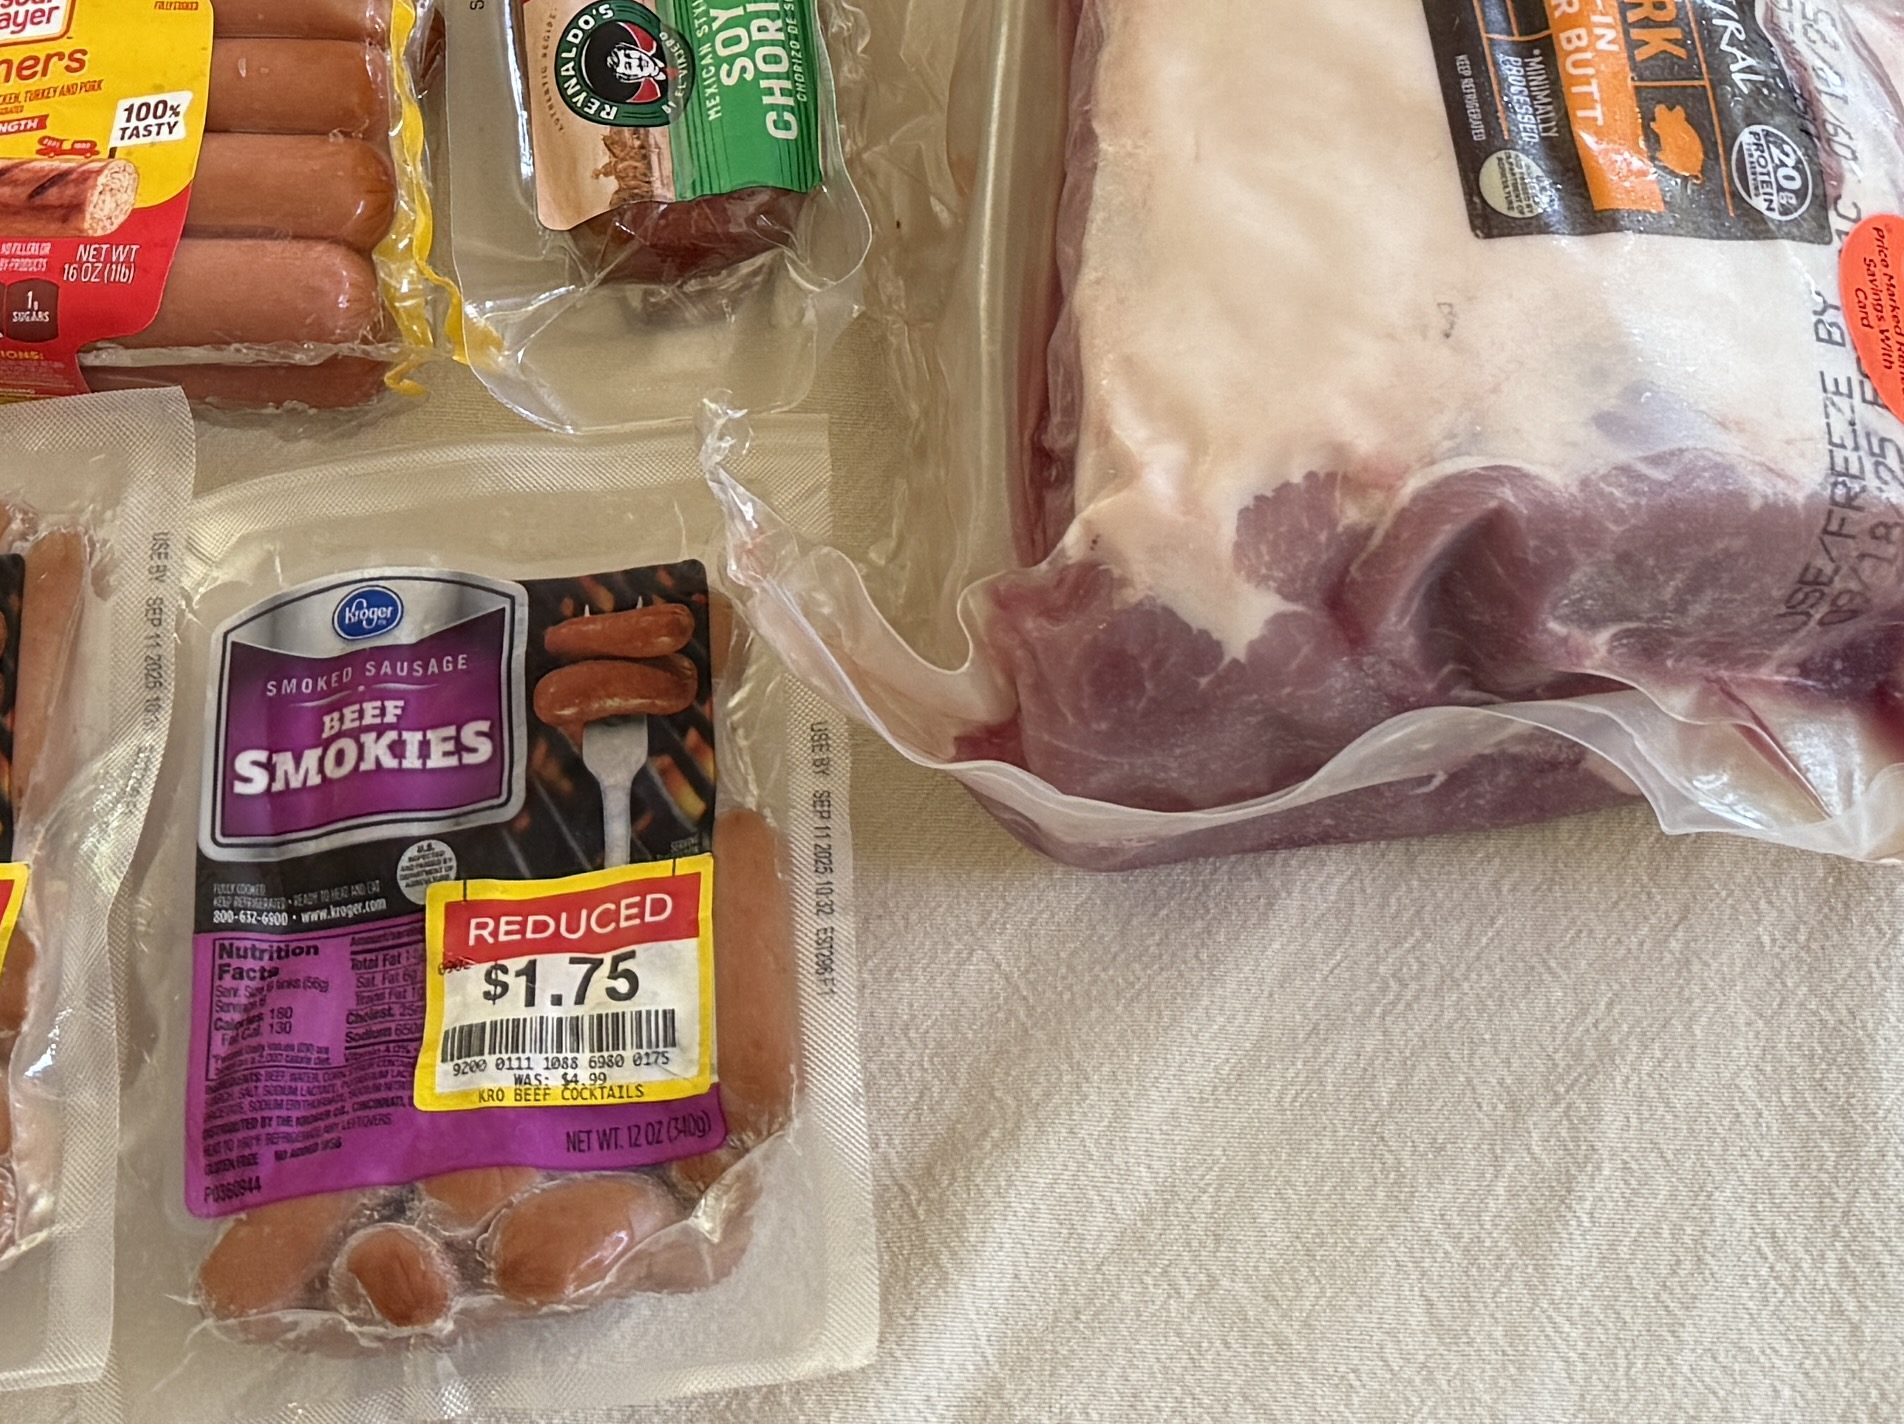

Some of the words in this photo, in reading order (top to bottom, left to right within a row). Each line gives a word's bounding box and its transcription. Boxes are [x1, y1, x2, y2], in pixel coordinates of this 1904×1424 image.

[710, 4, 754, 87] SOY
[699, 38, 722, 121] MEXICAN
[1558, 30, 1606, 126] BUTT
[118, 121, 179, 140] TASTY
[123, 99, 181, 124] 100%
[63, 264, 77, 282] 16
[79, 264, 103, 282] OZ
[76, 244, 110, 262] NET
[112, 244, 140, 262] WT
[265, 666, 354, 697] SMOKED
[365, 653, 469, 677] SAUSAGE
[320, 699, 405, 739] BEEF
[232, 719, 494, 795] SMOKIES
[300, 898, 387, 924] www.kroger.com
[468, 893, 673, 948] REDUCED
[482, 950, 641, 1010] $1.75
[477, 1088, 506, 1103] KRO
[514, 1087, 551, 1102] BEEF
[560, 1084, 644, 1102] COCKTAILS
[513, 1073, 550, 1087] WAS:
[560, 1072, 607, 1086] $4.99
